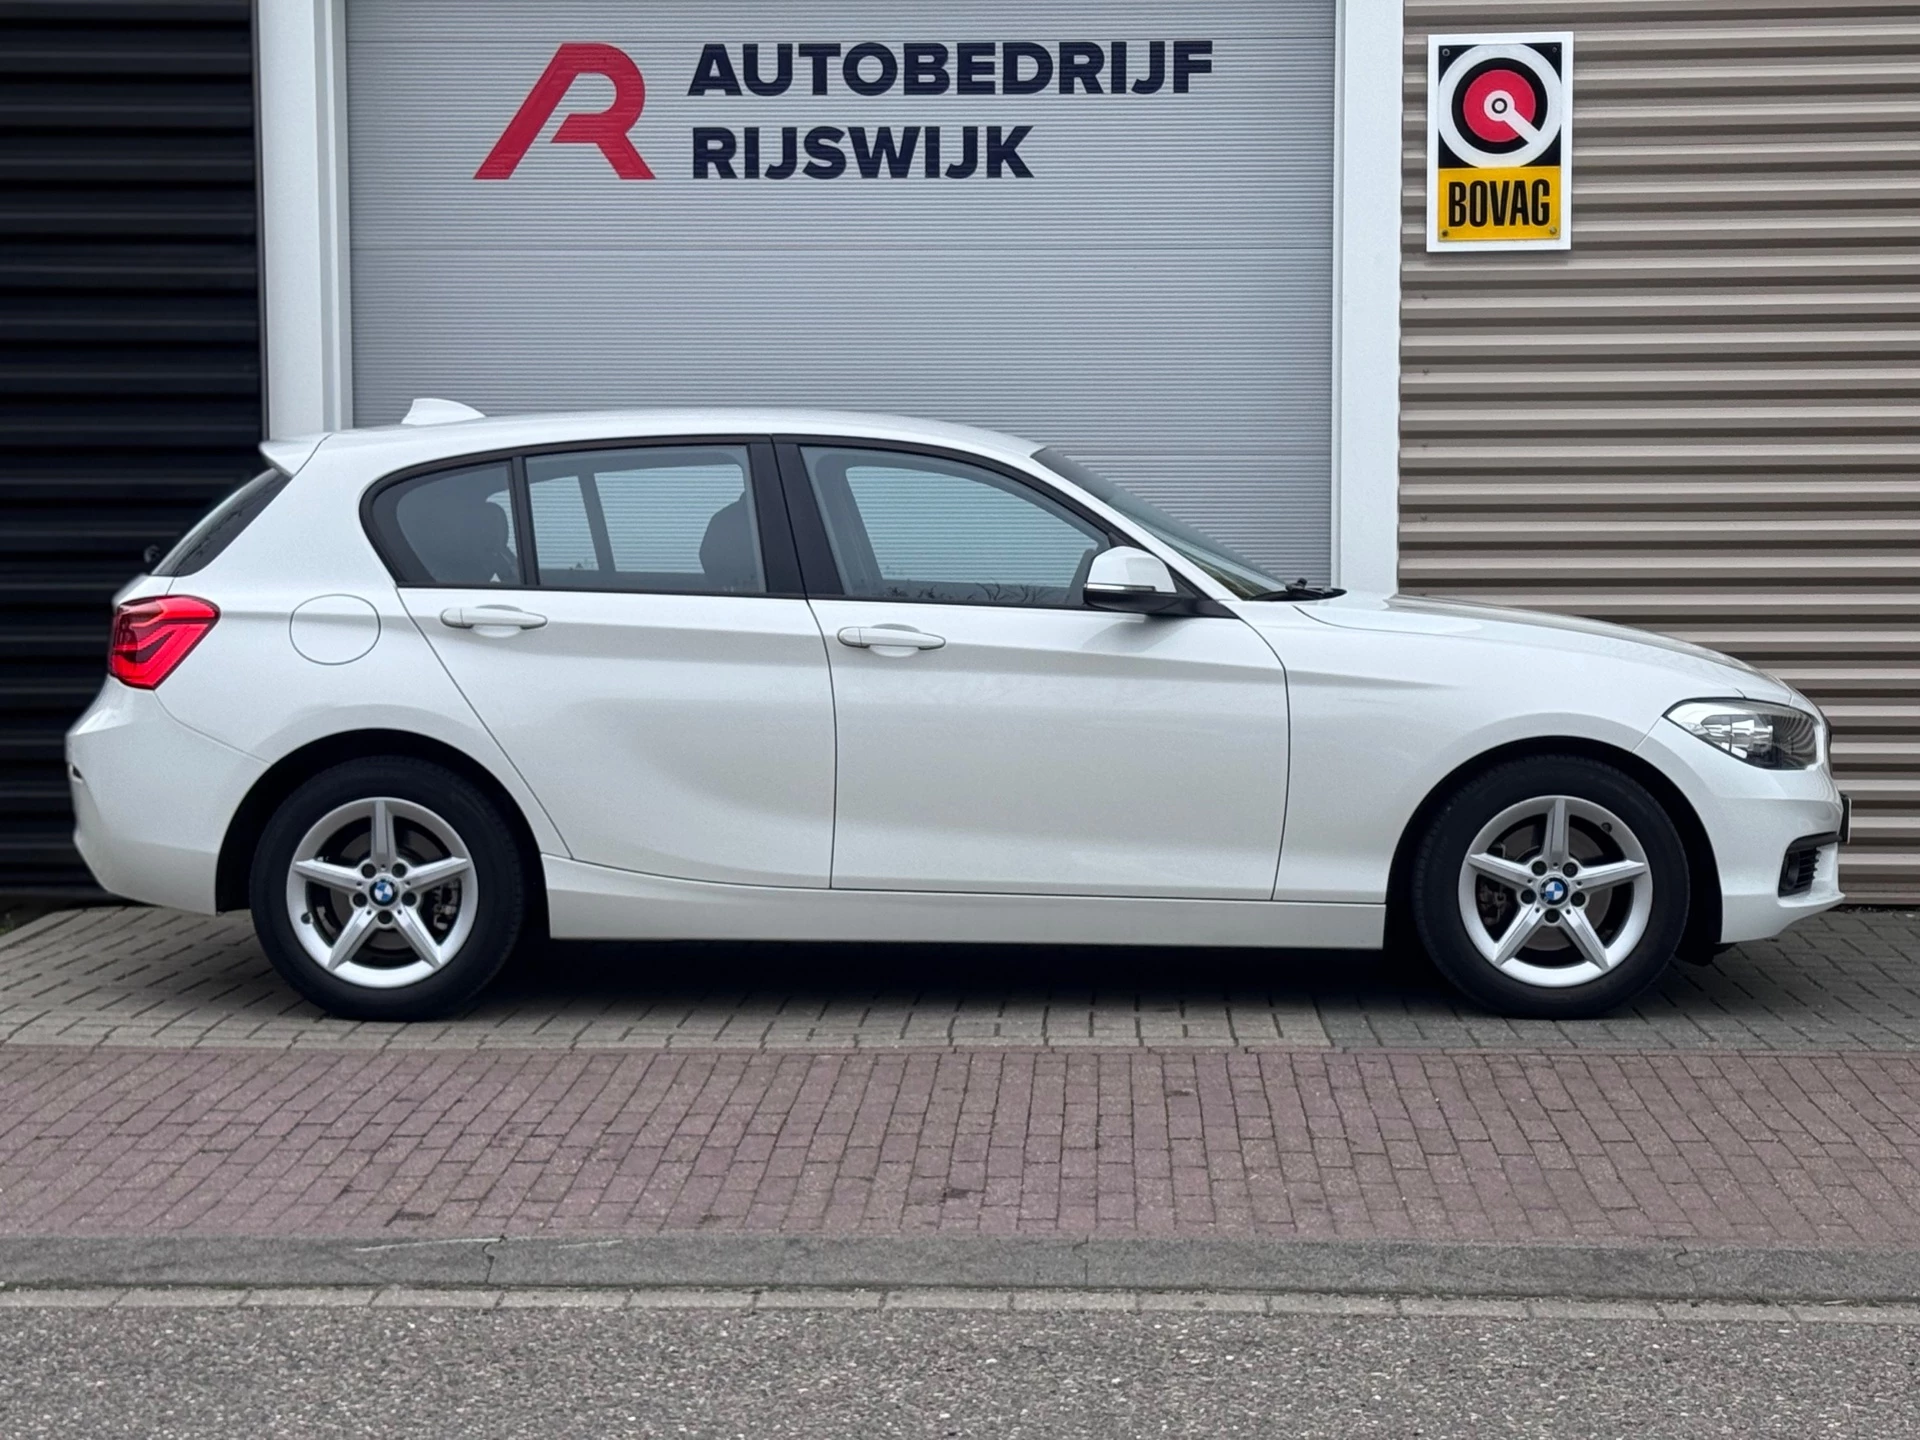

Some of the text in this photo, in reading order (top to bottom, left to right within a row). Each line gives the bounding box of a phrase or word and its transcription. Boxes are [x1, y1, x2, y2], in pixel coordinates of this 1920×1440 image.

[687, 41, 1213, 97] AUTOBEDRIJF
[693, 126, 1034, 180] RIJSWIJK
[1448, 179, 1550, 227] BOVAG
